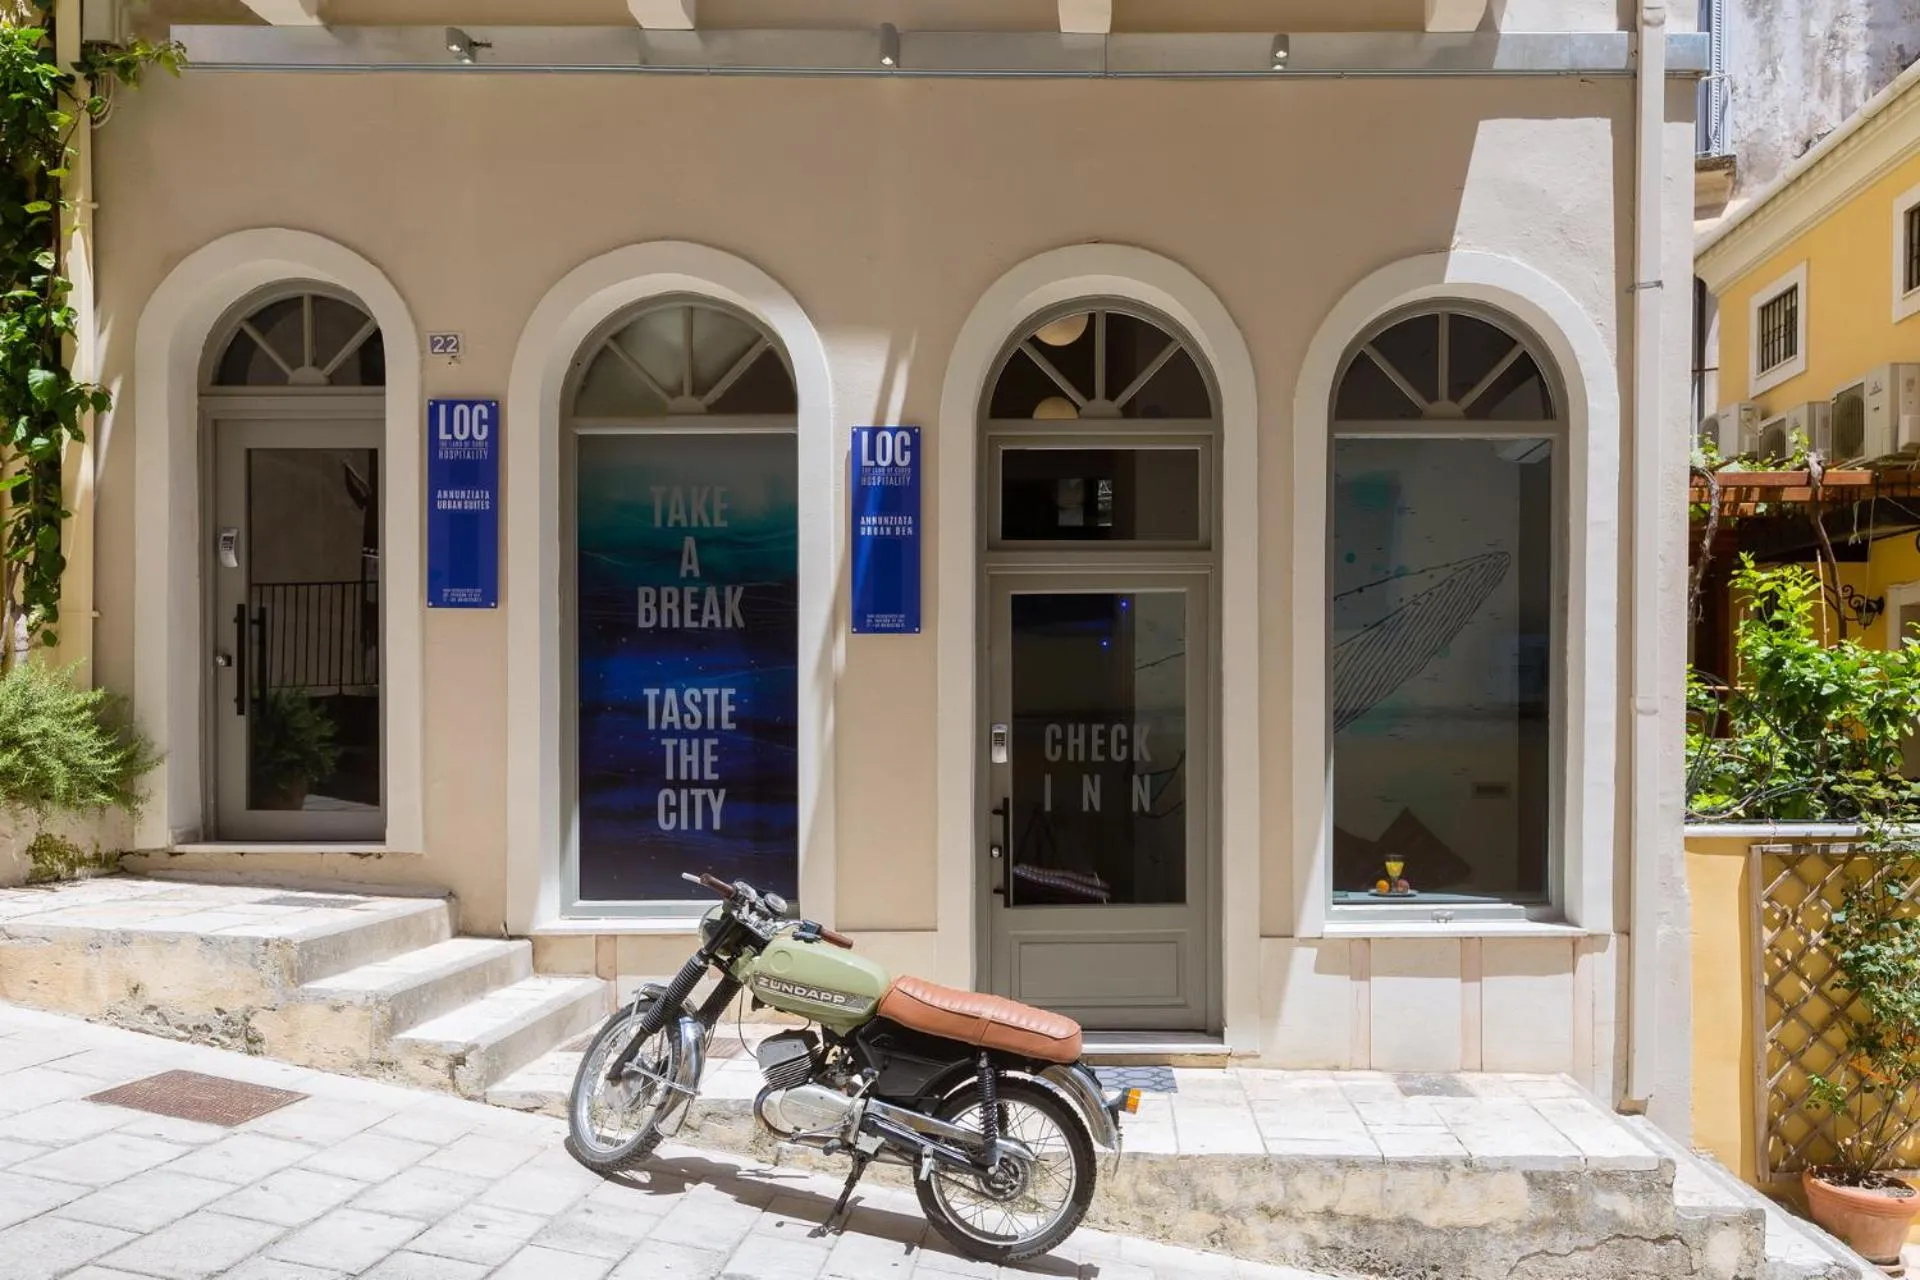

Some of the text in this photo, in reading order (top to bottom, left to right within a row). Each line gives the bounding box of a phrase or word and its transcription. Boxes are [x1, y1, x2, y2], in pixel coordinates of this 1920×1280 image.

[433, 336, 457, 353] 22
[438, 403, 489, 441] LOC
[438, 449, 489, 460] HOSPITALITY
[862, 430, 911, 467] LOC
[861, 476, 911, 486] HOSPITALITY
[650, 485, 728, 528] TAKE
[679, 536, 701, 578] A
[637, 586, 745, 628] BREAK
[643, 688, 737, 730] TASTE
[660, 738, 720, 781] THE
[1045, 723, 1152, 762] CHECK
[656, 788, 727, 831] CITY
